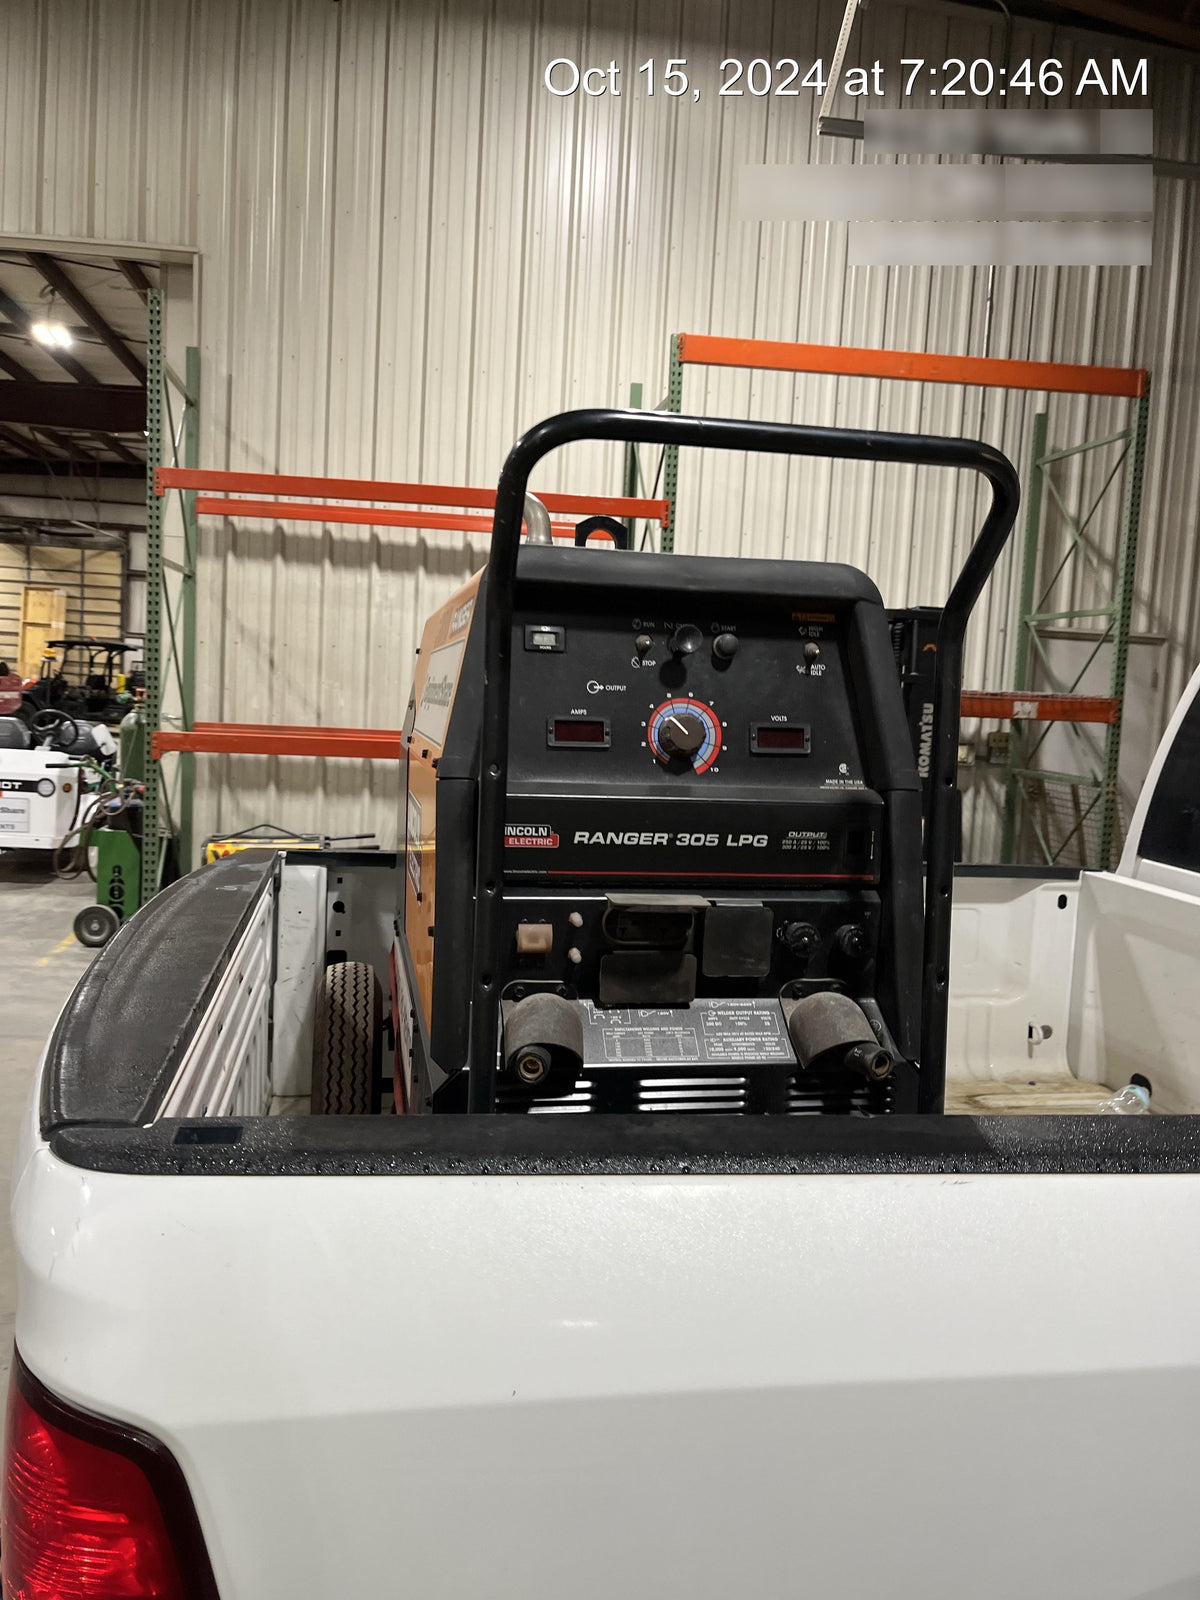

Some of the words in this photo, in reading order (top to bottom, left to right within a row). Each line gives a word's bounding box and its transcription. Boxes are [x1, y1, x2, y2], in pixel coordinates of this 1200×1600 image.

[605, 684, 627, 692] OUTPUT
[770, 714, 788, 722] VOLTS
[918, 702, 935, 779] KOMATSU
[0, 781, 23, 790] OT
[504, 826, 548, 837] INCOLN
[788, 831, 824, 839] OUTPUT
[508, 837, 553, 846] ELECTRIC
[573, 831, 669, 846] RANGER
[675, 833, 720, 847] 305
[726, 834, 769, 848] LPG
